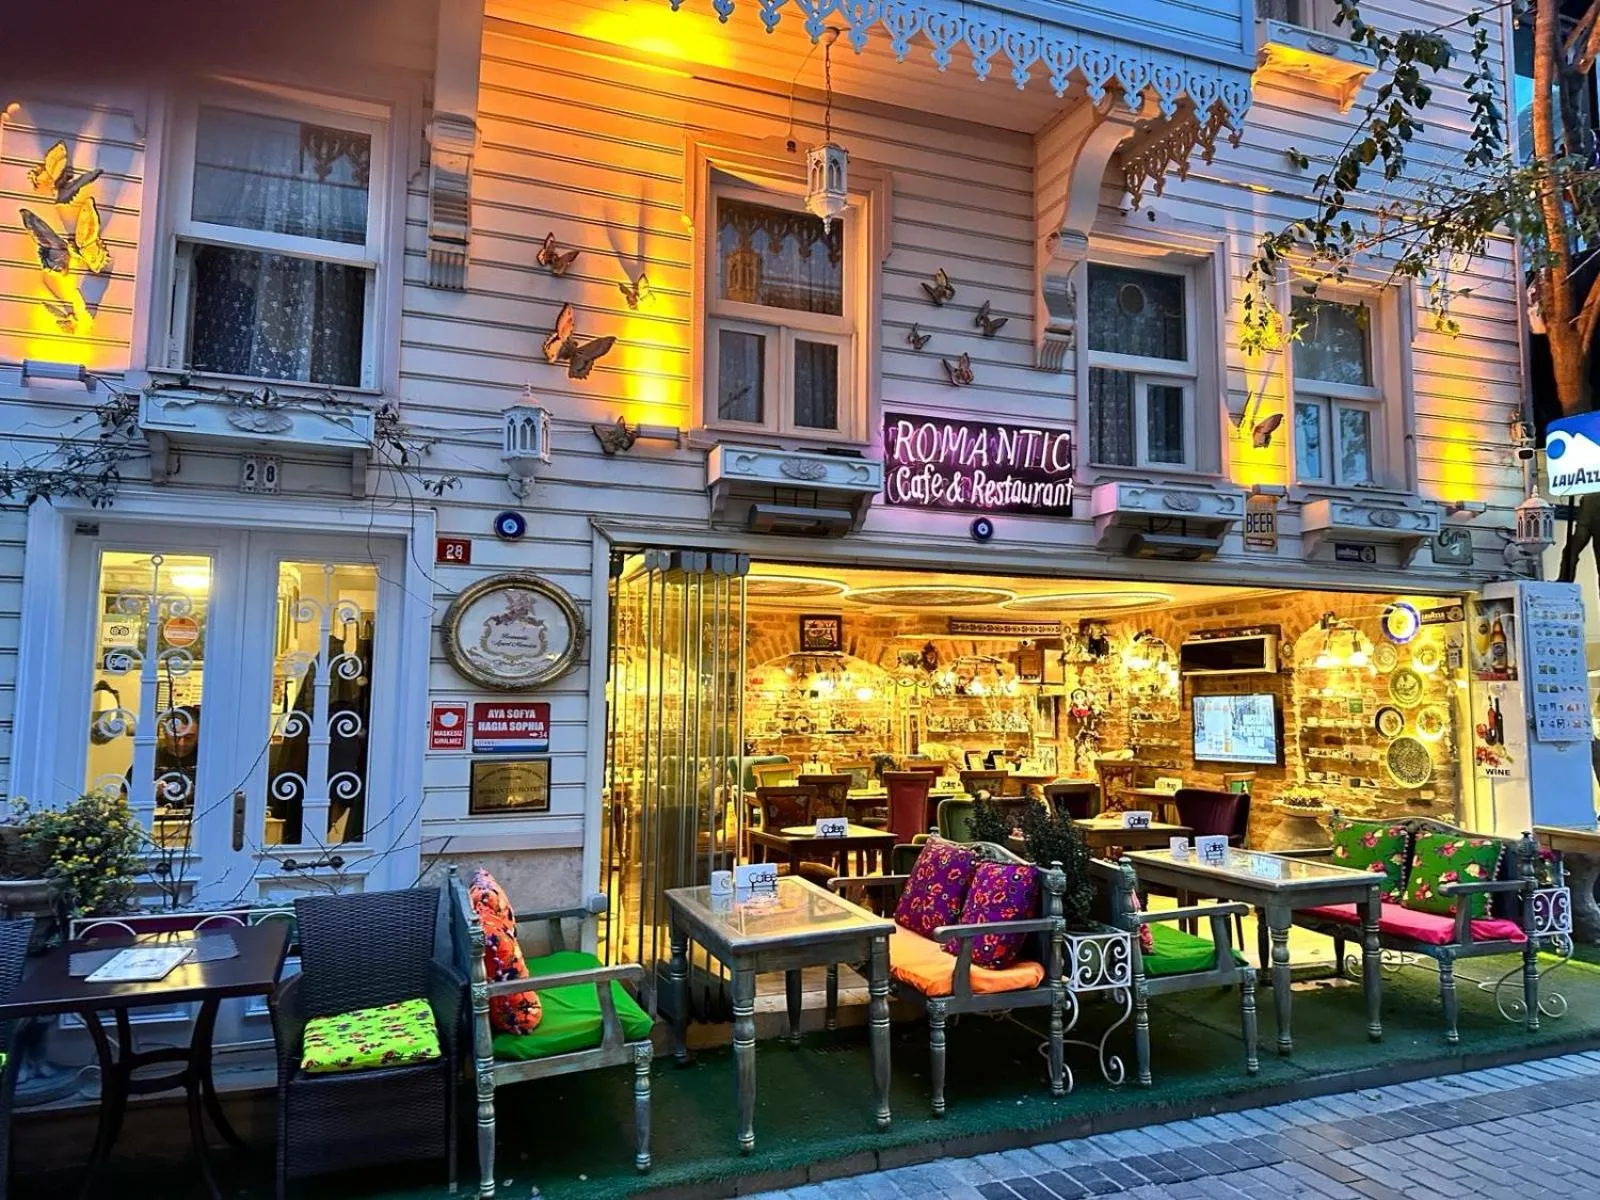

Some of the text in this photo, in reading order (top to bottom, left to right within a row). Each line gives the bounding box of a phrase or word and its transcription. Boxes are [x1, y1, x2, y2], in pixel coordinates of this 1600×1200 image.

[893, 420, 1071, 471] ROMANTIC
[245, 462, 276, 483] 28
[897, 464, 1074, 506] Cafe & Restaurant
[1246, 512, 1274, 533] BEER
[446, 543, 463, 560] 28
[487, 708, 537, 719] AYA SOFYA
[478, 721, 545, 732] HAGIA SOPHIA
[1485, 768, 1511, 777] WINE
